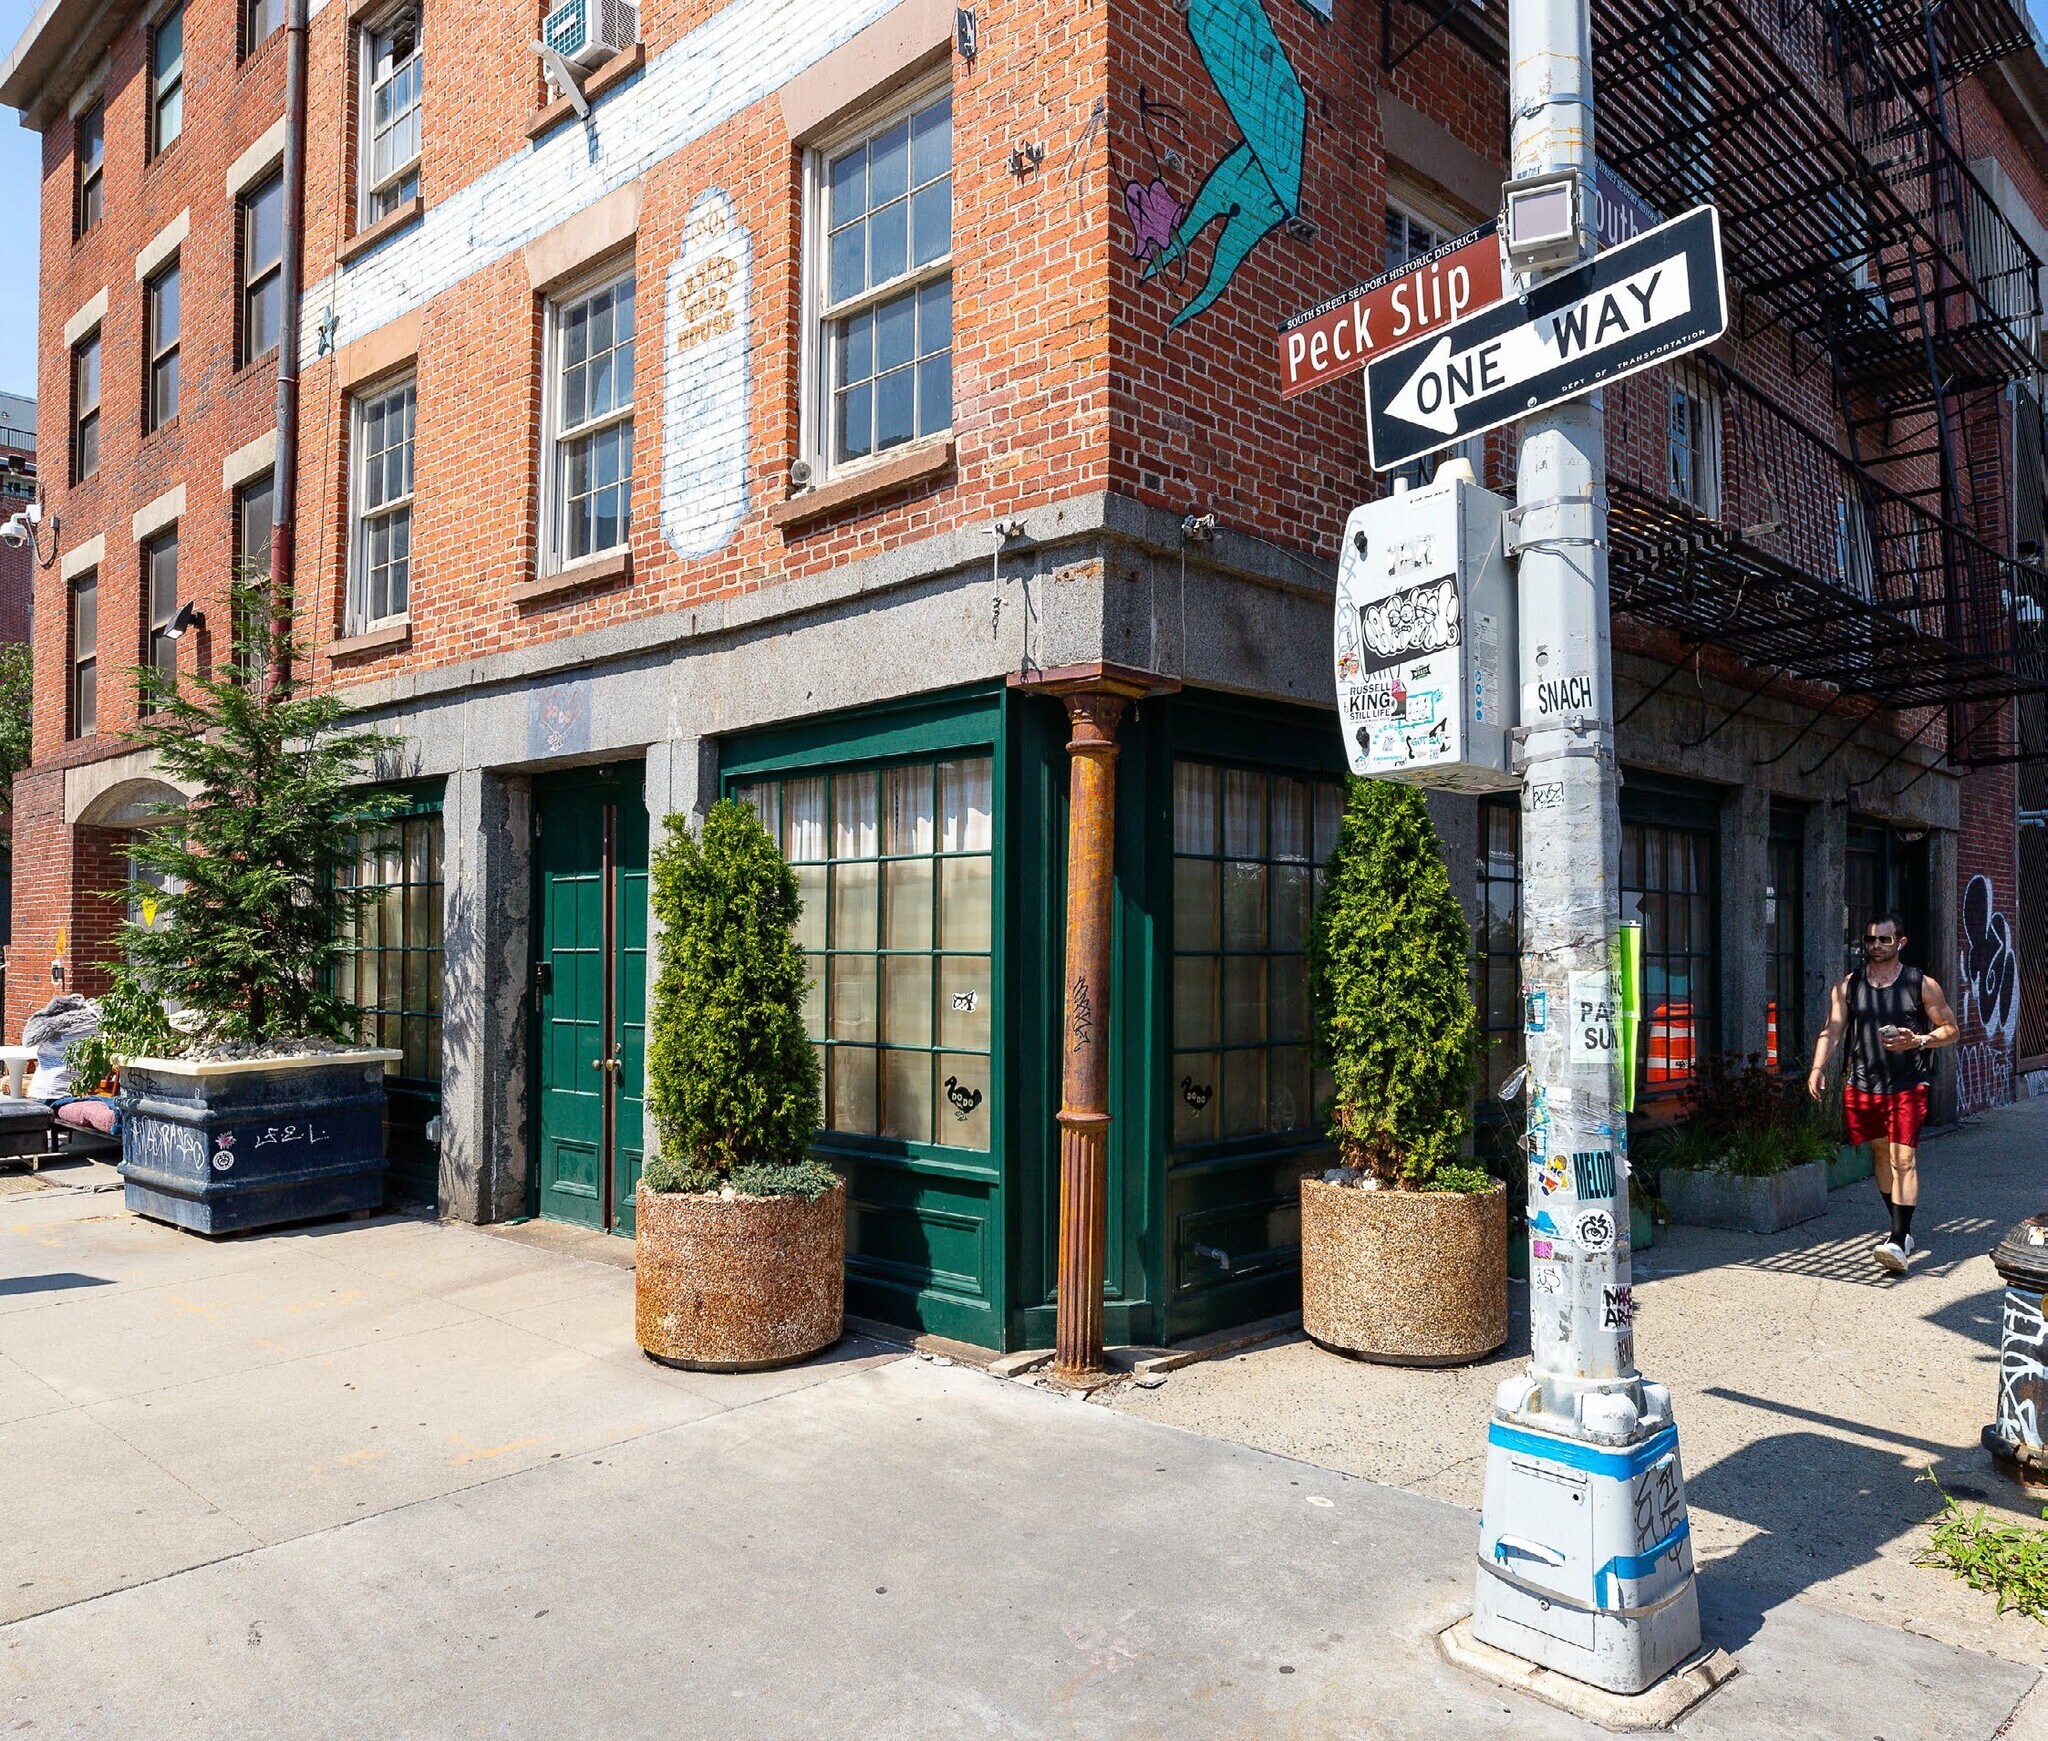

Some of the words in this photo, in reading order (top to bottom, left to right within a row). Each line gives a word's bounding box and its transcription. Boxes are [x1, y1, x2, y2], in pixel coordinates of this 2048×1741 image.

[1595, 189, 1639, 245] outh
[1287, 308, 1315, 330] SOUTH
[1316, 294, 1347, 316] STREET
[1348, 274, 1388, 300] SEAPORT
[1389, 252, 1433, 281] HISTORIC
[1434, 229, 1481, 259] DISTRICT
[1288, 300, 1375, 383] Peck
[1391, 262, 1471, 338] Slip
[1417, 342, 1506, 415] ONE
[1552, 269, 1663, 359] WAY
[1561, 378, 1585, 392] DEPT
[1595, 368, 1608, 379] OF
[1616, 328, 1706, 369] TRANSPORTATION
[1350, 682, 1391, 695] RUSSELL
[1350, 692, 1391, 712] KING
[1538, 677, 1593, 715] SNACH
[1350, 711, 1371, 721] STILL
[1373, 708, 1391, 718] LIFE
[1584, 1027, 1618, 1050] SUN
